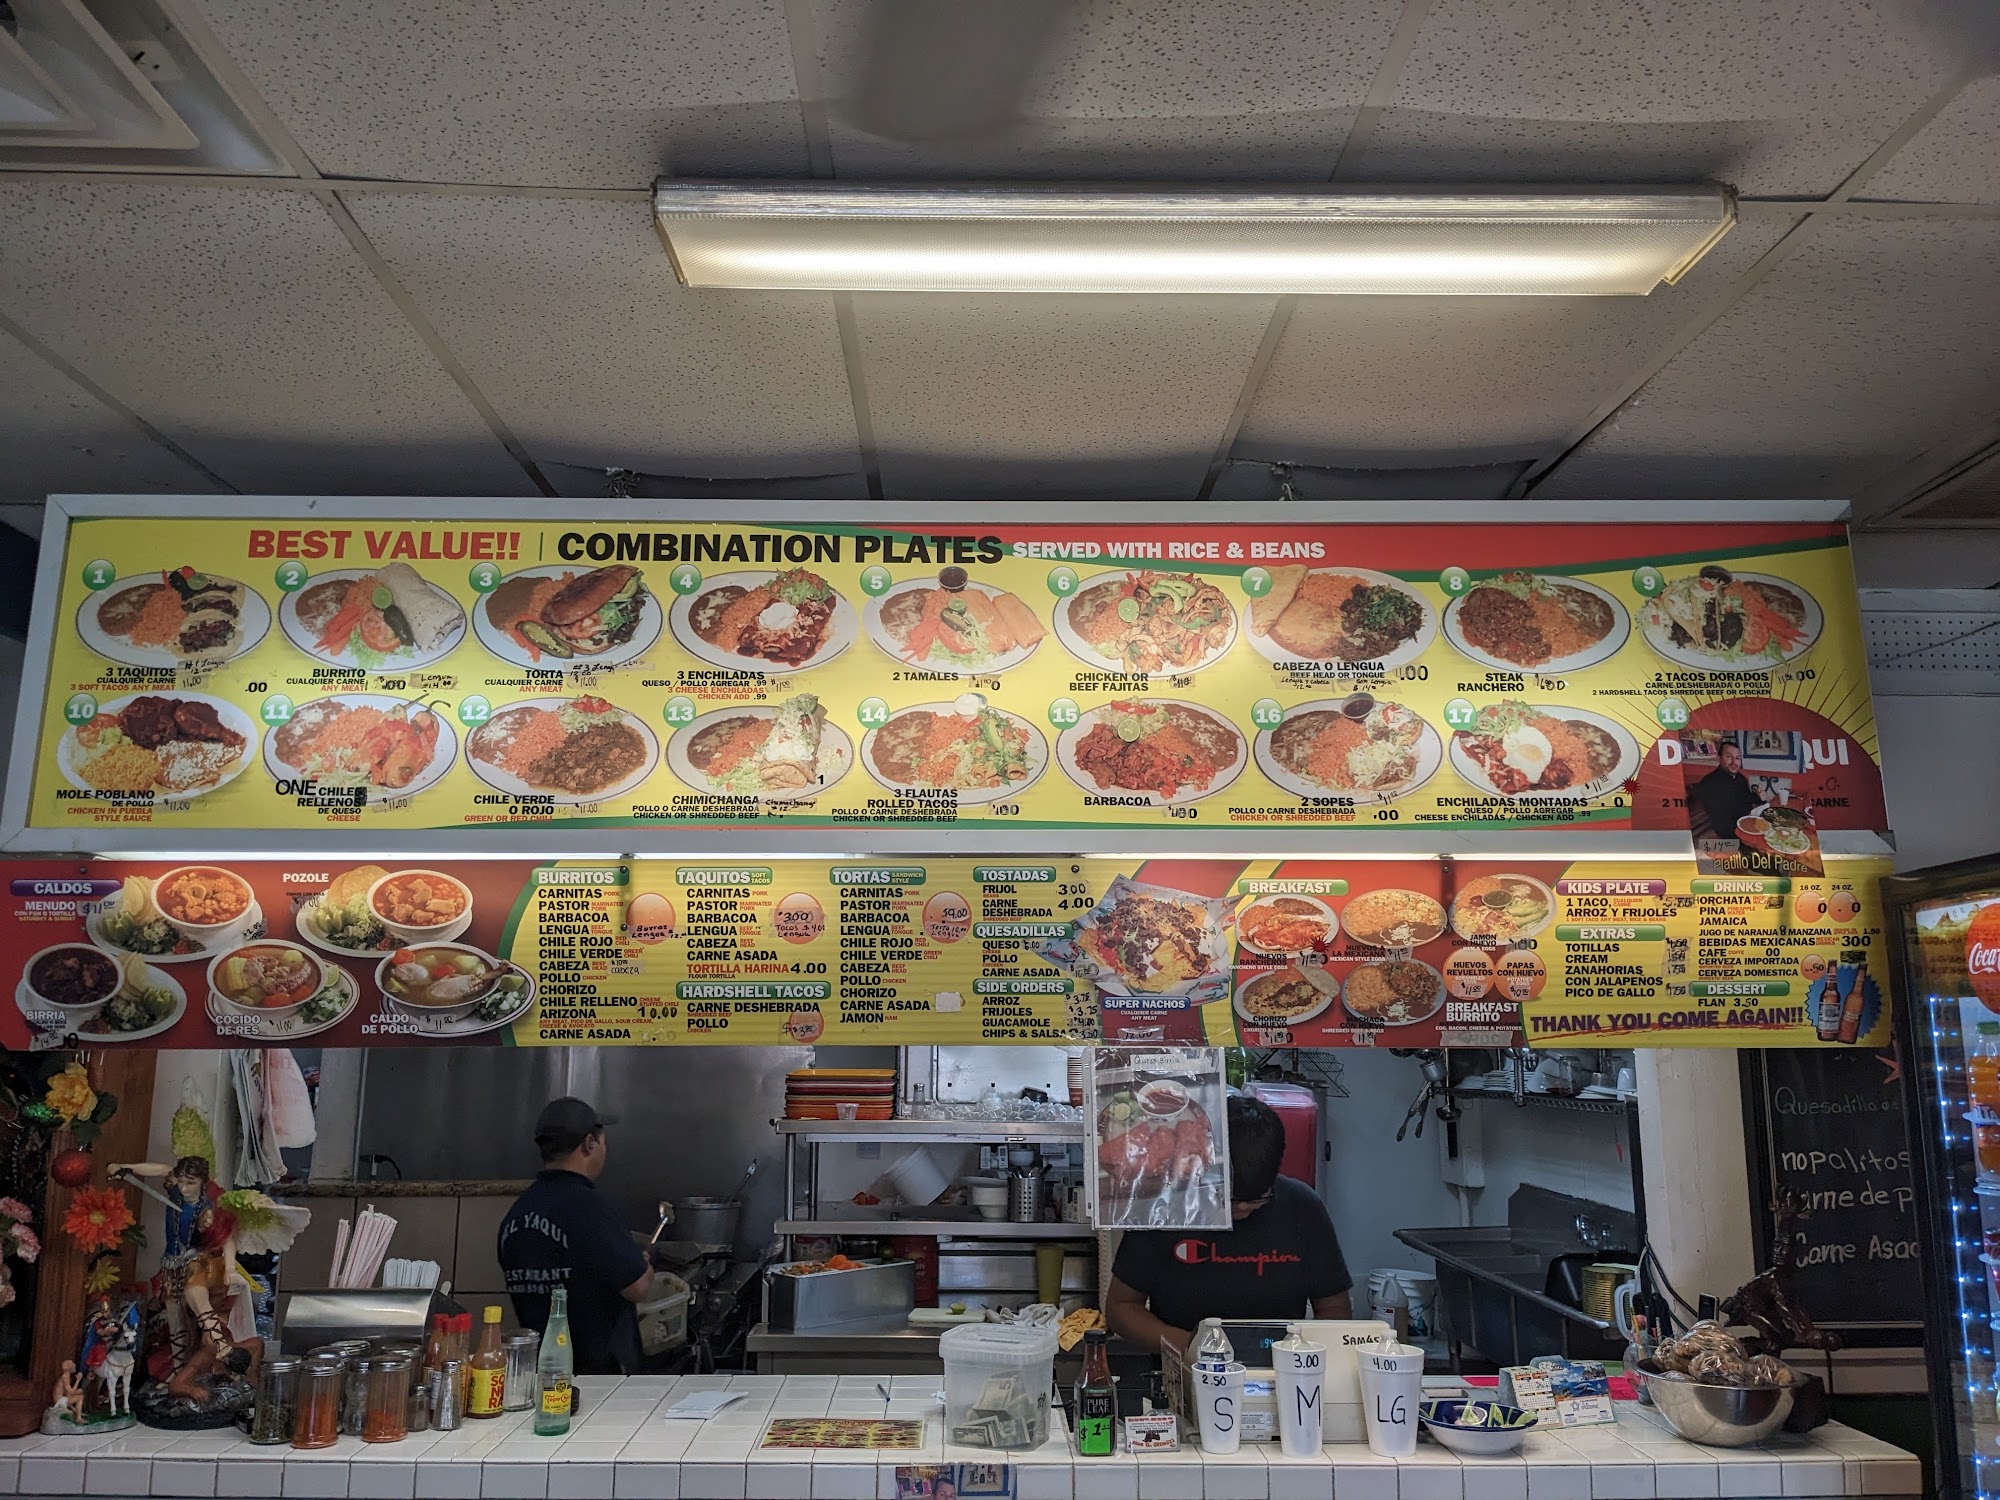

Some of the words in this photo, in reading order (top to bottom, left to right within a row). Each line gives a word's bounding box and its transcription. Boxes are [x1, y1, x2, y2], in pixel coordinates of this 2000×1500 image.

[247, 530, 353, 559] BEST
[364, 530, 521, 560] VALUE!!
[558, 532, 841, 563] COMBINATION
[855, 535, 1004, 564] PLATES
[1013, 541, 1101, 559] SERVED
[1106, 542, 1166, 559] WITH
[1168, 542, 1220, 559] RICE
[1225, 542, 1245, 559] &
[1250, 542, 1326, 559] BEANS
[1641, 576, 1654, 591] 9
[106, 667, 114, 677] 3
[116, 667, 177, 678] TAQUITOS
[1272, 662, 1321, 672] CABEZA
[1324, 662, 1334, 672] O
[1337, 662, 1386, 672] LENGUA
[312, 669, 366, 678] BURRITO
[524, 669, 564, 679] TORTA
[676, 670, 685, 681] 3
[687, 670, 765, 681] ENCHILADAS
[892, 672, 900, 681] 2
[903, 672, 960, 682] TAMALES
[1075, 672, 1130, 682] CHICKEN
[1131, 672, 1149, 682] OR
[1485, 672, 1524, 682] STEAK
[1654, 673, 1663, 682] 2
[1665, 673, 1706, 682] TACOS
[1709, 673, 1770, 682] DORADOS
[97, 677, 141, 685] CUALQUIER
[144, 677, 176, 685] CARNE
[1069, 682, 1099, 692] BEEF
[1102, 682, 1149, 692] FAJITAS
[1457, 682, 1525, 692] RANCHERO
[69, 704, 95, 719] 10
[264, 704, 291, 719] 11
[667, 705, 694, 721] 13
[861, 706, 887, 722] 14
[1052, 707, 1077, 722] 15
[1255, 708, 1280, 724] 16
[1447, 708, 1472, 724] 17
[1660, 703, 1687, 719] 18
[275, 779, 318, 796] ONE
[894, 788, 902, 798] 3
[905, 788, 958, 798] FLAUTAS
[56, 790, 92, 800] MOLE
[94, 790, 155, 800] POBLANO
[473, 795, 511, 805] CHILE
[513, 795, 556, 805] VERDE
[671, 795, 760, 805] CHIMICHANGA
[867, 799, 914, 809] ROLLED
[916, 799, 958, 809] TACOS
[1083, 796, 1151, 806] BARBACOA
[1301, 797, 1310, 807] 2
[1313, 797, 1355, 807] SOPES
[1437, 797, 1516, 807] ENCHILADAS
[1519, 797, 1589, 807] MONTADAS
[508, 805, 519, 815] O
[521, 805, 555, 816] ROJO
[1713, 852, 1749, 869] Platillo
[1751, 852, 1774, 870] Del
[1774, 853, 1809, 874] Padre
[282, 873, 330, 883] POZOLE
[538, 871, 616, 884] BURRITOS
[676, 871, 751, 886] TAQUITOS
[832, 870, 892, 884] TORTAS
[981, 869, 1049, 882] TOSTADAS
[34, 883, 93, 895] CALDOS
[982, 884, 1017, 894] FRIJOL
[1249, 882, 1332, 894] BREAKFAST
[1567, 882, 1602, 894] KIDS
[1605, 882, 1650, 894] PLATE
[1713, 881, 1764, 893] DRINKS
[538, 888, 603, 899] CARNITAS
[25, 901, 76, 911] MENUDO
[538, 900, 590, 911] PASTOR
[1057, 896, 1094, 911] 4.00
[686, 913, 757, 924] BARBACOA
[1698, 917, 1748, 926] JAMAICA
[538, 924, 590, 935] LENGUA
[976, 925, 1066, 939] QUESADILLAS
[1579, 928, 1636, 940] EXTRAS
[686, 938, 738, 949] CABEZA
[1565, 943, 1620, 953] TOTILLAS
[686, 963, 741, 974] TORTILLA
[744, 963, 790, 974] HARINA
[790, 962, 827, 974] 4.00
[1506, 962, 1535, 970] PAPAS
[1496, 969, 1515, 977] CON
[1516, 969, 1544, 977] HUEVO
[539, 984, 597, 995] CHORIZO
[682, 985, 772, 998] HARDSHELL
[775, 985, 825, 998] TACOS
[977, 982, 1008, 993] SIDE
[1010, 982, 1065, 993] ORDERS
[1707, 983, 1767, 995] DESSERT
[981, 996, 1020, 1006] ARROZ
[1104, 999, 1140, 1009] SUPER
[1142, 1000, 1186, 1009] NACHOS
[1697, 998, 1727, 1007] FLAN
[982, 1007, 1033, 1017] FRIJOLES
[1446, 1002, 1519, 1013] BREAKFAST
[26, 1010, 66, 1021] BIRRIA
[369, 1013, 410, 1024] CALDO
[539, 1008, 597, 1019] ARIZONA
[839, 1012, 884, 1023] JAMON
[1446, 1012, 1501, 1022] BURRITO
[215, 1015, 261, 1025] COCIDO
[1528, 1014, 1602, 1033] THANK
[1606, 1012, 1652, 1031] YOU
[1657, 1010, 1719, 1028] COME
[1725, 1006, 1804, 1026] AGAIN!!
[216, 1026, 234, 1036] DE
[235, 1026, 260, 1036] RES
[361, 1023, 378, 1034] DE
[380, 1023, 420, 1034] POLLO
[1781, 1148, 1911, 1175] nopalitos
[1800, 1190, 1856, 1211] arne
[1860, 1179, 1891, 1206] de
[523, 1211, 569, 1249] YAQUI
[1173, 1239, 1302, 1277] Champion
[1292, 1353, 1320, 1369] 3.00
[1372, 1357, 1398, 1372] 4.00
[1201, 1373, 1227, 1387] 2.50
[1087, 1398, 1110, 1407] PURE
[1296, 1384, 1321, 1427] M
[1086, 1406, 1109, 1414] LEAF
[1213, 1396, 1234, 1432] S
[1376, 1394, 1407, 1426] LG
